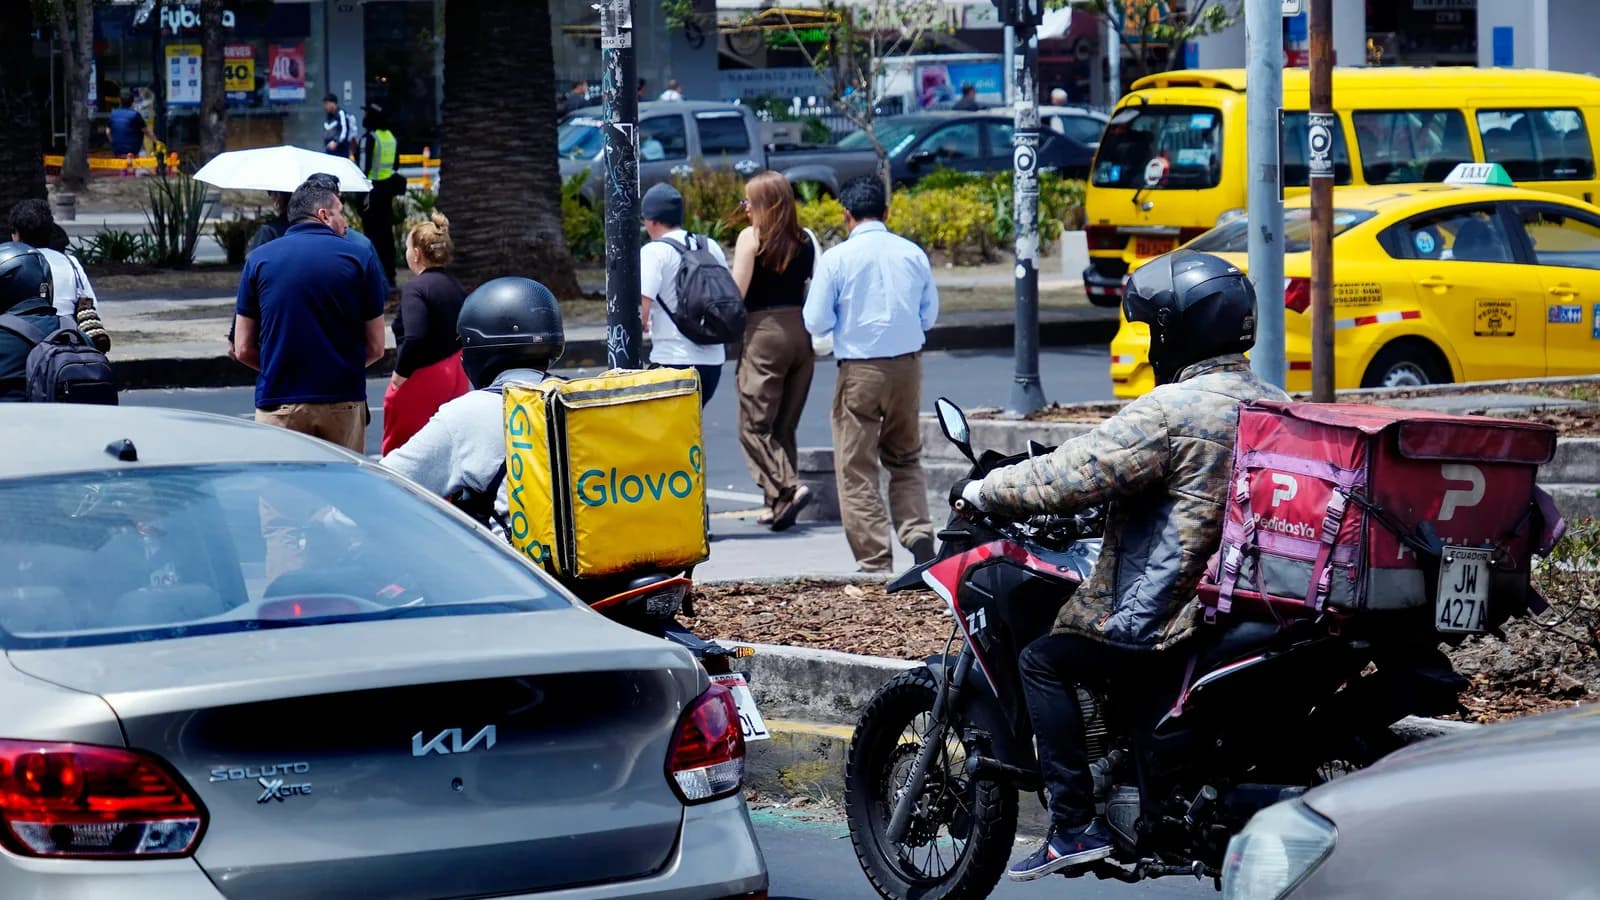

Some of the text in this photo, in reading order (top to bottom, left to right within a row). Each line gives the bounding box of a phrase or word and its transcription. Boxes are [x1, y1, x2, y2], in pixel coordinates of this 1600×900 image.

[160, 4, 236, 34] Fyba
[224, 47, 251, 57] UEVES
[224, 65, 249, 80] 40
[1460, 166, 1490, 178] TAXI
[509, 404, 533, 540] Glovo
[577, 467, 692, 507] Glovo
[1253, 512, 1315, 539] PedidosYa
[1451, 551, 1488, 560] ECUADOR
[1454, 564, 1478, 594] JW
[1440, 599, 1488, 630] 427A
[412, 724, 497, 757] KIA
[209, 762, 310, 782] SOLUTO
